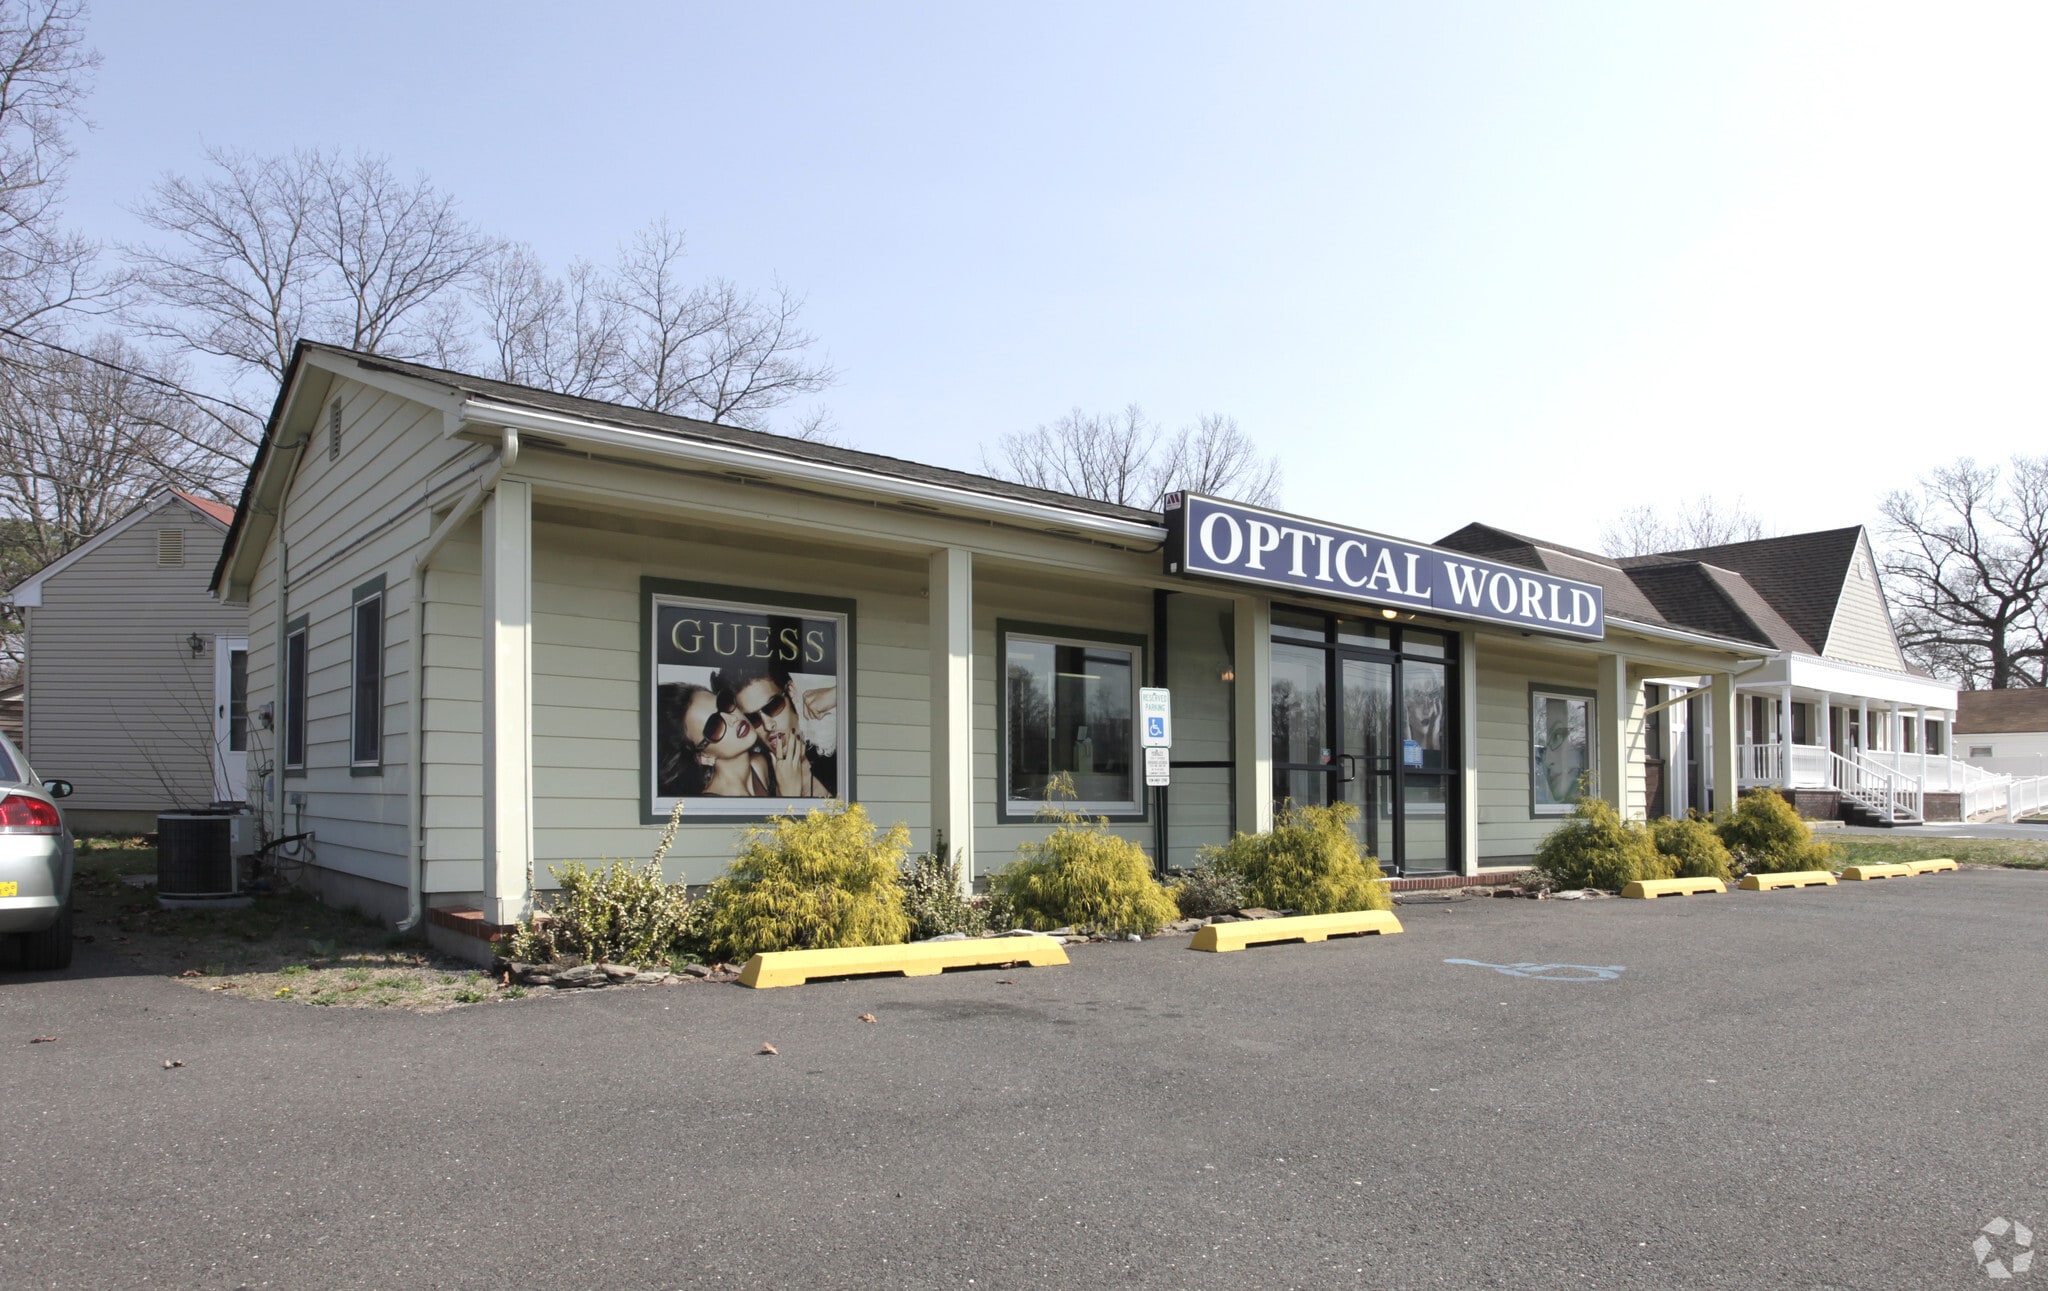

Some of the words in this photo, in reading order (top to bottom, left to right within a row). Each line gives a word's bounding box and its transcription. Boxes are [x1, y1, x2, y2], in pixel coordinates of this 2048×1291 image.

[1200, 512, 1431, 599] OPTICAL
[1443, 561, 1597, 628] WORLD
[671, 618, 825, 663] GUESS
[1142, 693, 1168, 703] RESERVED
[1144, 703, 1166, 712] PARKING
